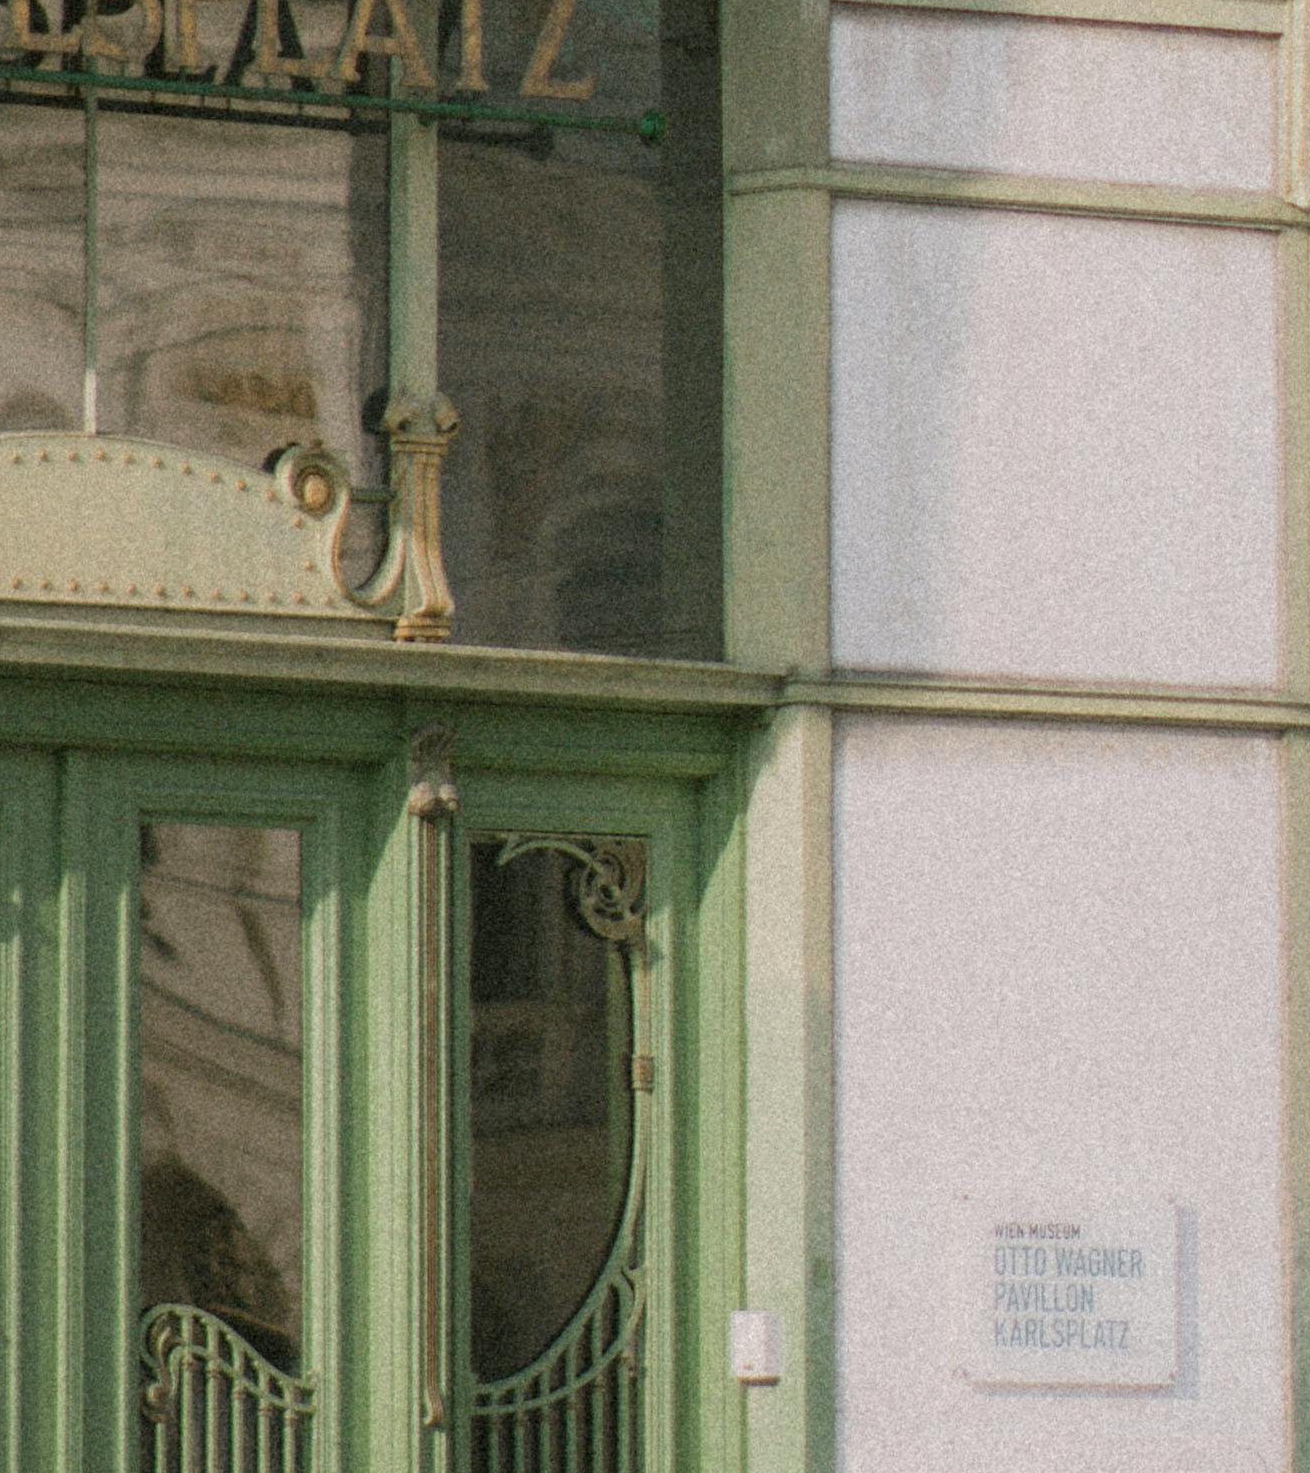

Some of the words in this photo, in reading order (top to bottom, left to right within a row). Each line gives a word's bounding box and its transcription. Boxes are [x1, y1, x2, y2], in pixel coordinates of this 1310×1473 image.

[994, 1223, 1024, 1239] WIEN
[1029, 1224, 1081, 1240] MUSEUM
[994, 1246, 1046, 1277] OTTO
[1055, 1247, 1143, 1278] WAGNER
[994, 1282, 1095, 1313] PAVILLON
[994, 1318, 1130, 1349] KARLSPLATZ
